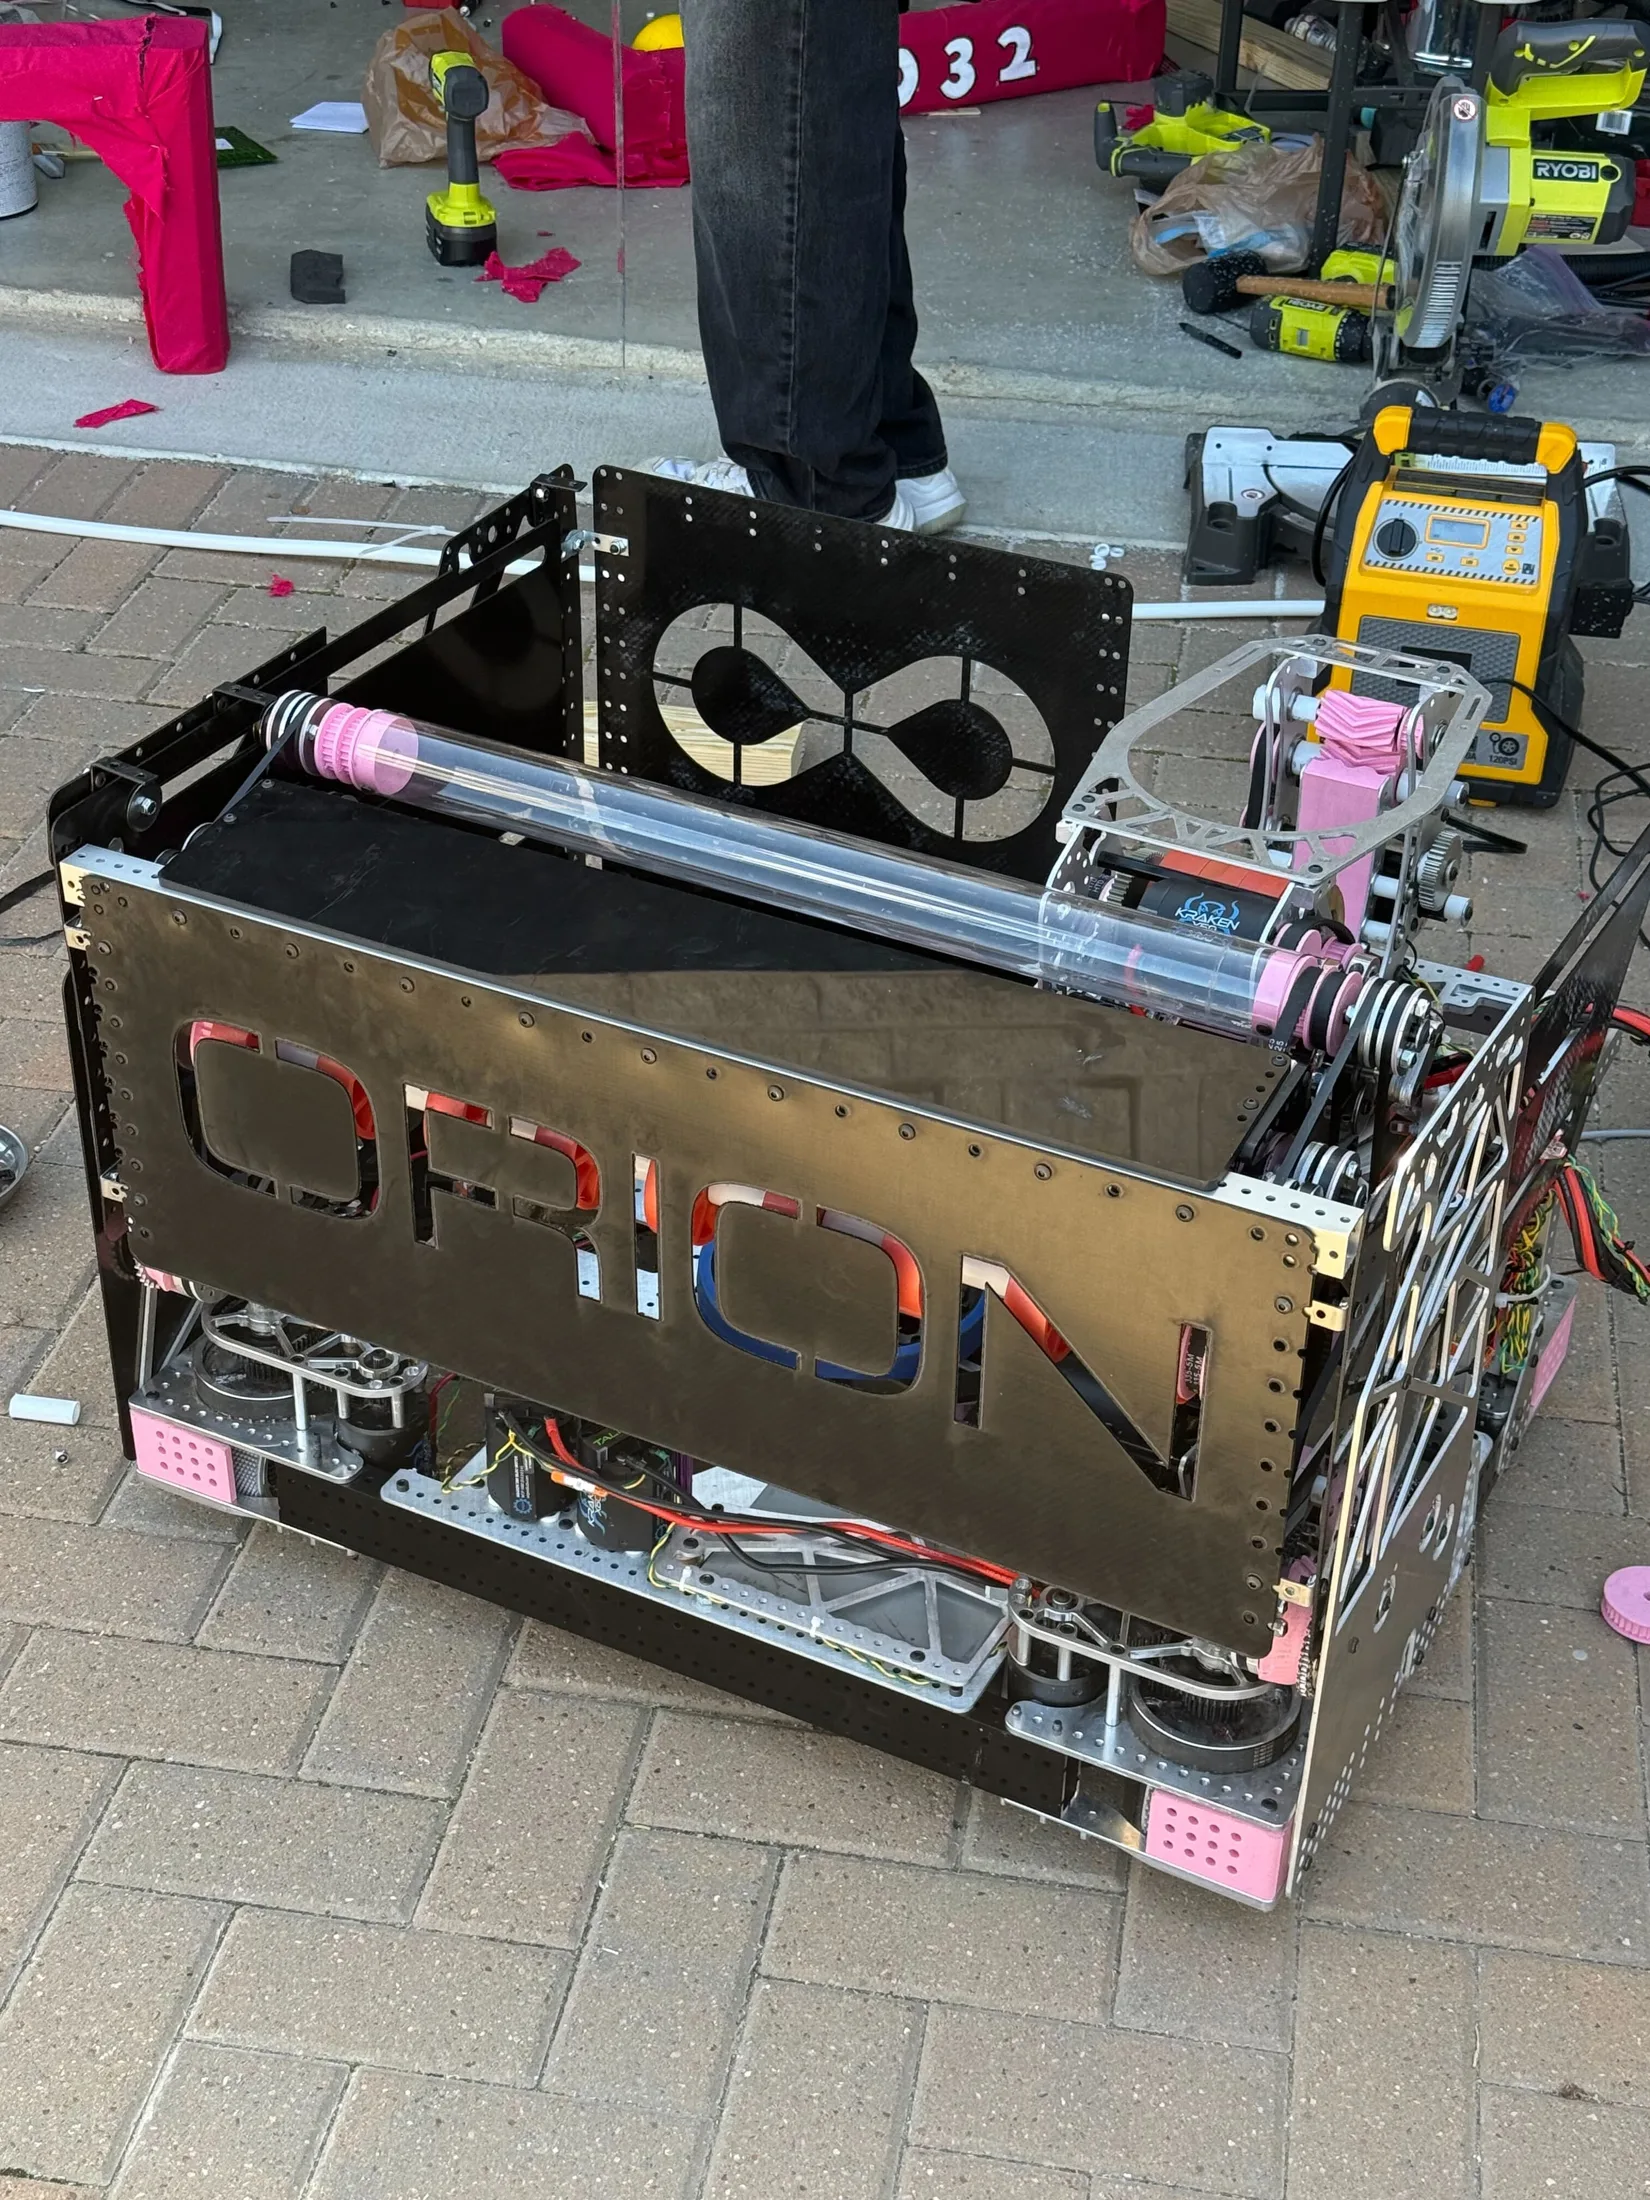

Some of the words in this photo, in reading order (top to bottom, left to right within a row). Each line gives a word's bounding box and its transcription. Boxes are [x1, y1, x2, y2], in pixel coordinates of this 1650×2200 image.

[1535, 161, 1597, 180] RYOBI
[1488, 755, 1518, 766] 120PSI
[1175, 907, 1240, 931] KRAKEN
[174, 1018, 1211, 1502] ORION
[593, 1431, 621, 1446] TAL
